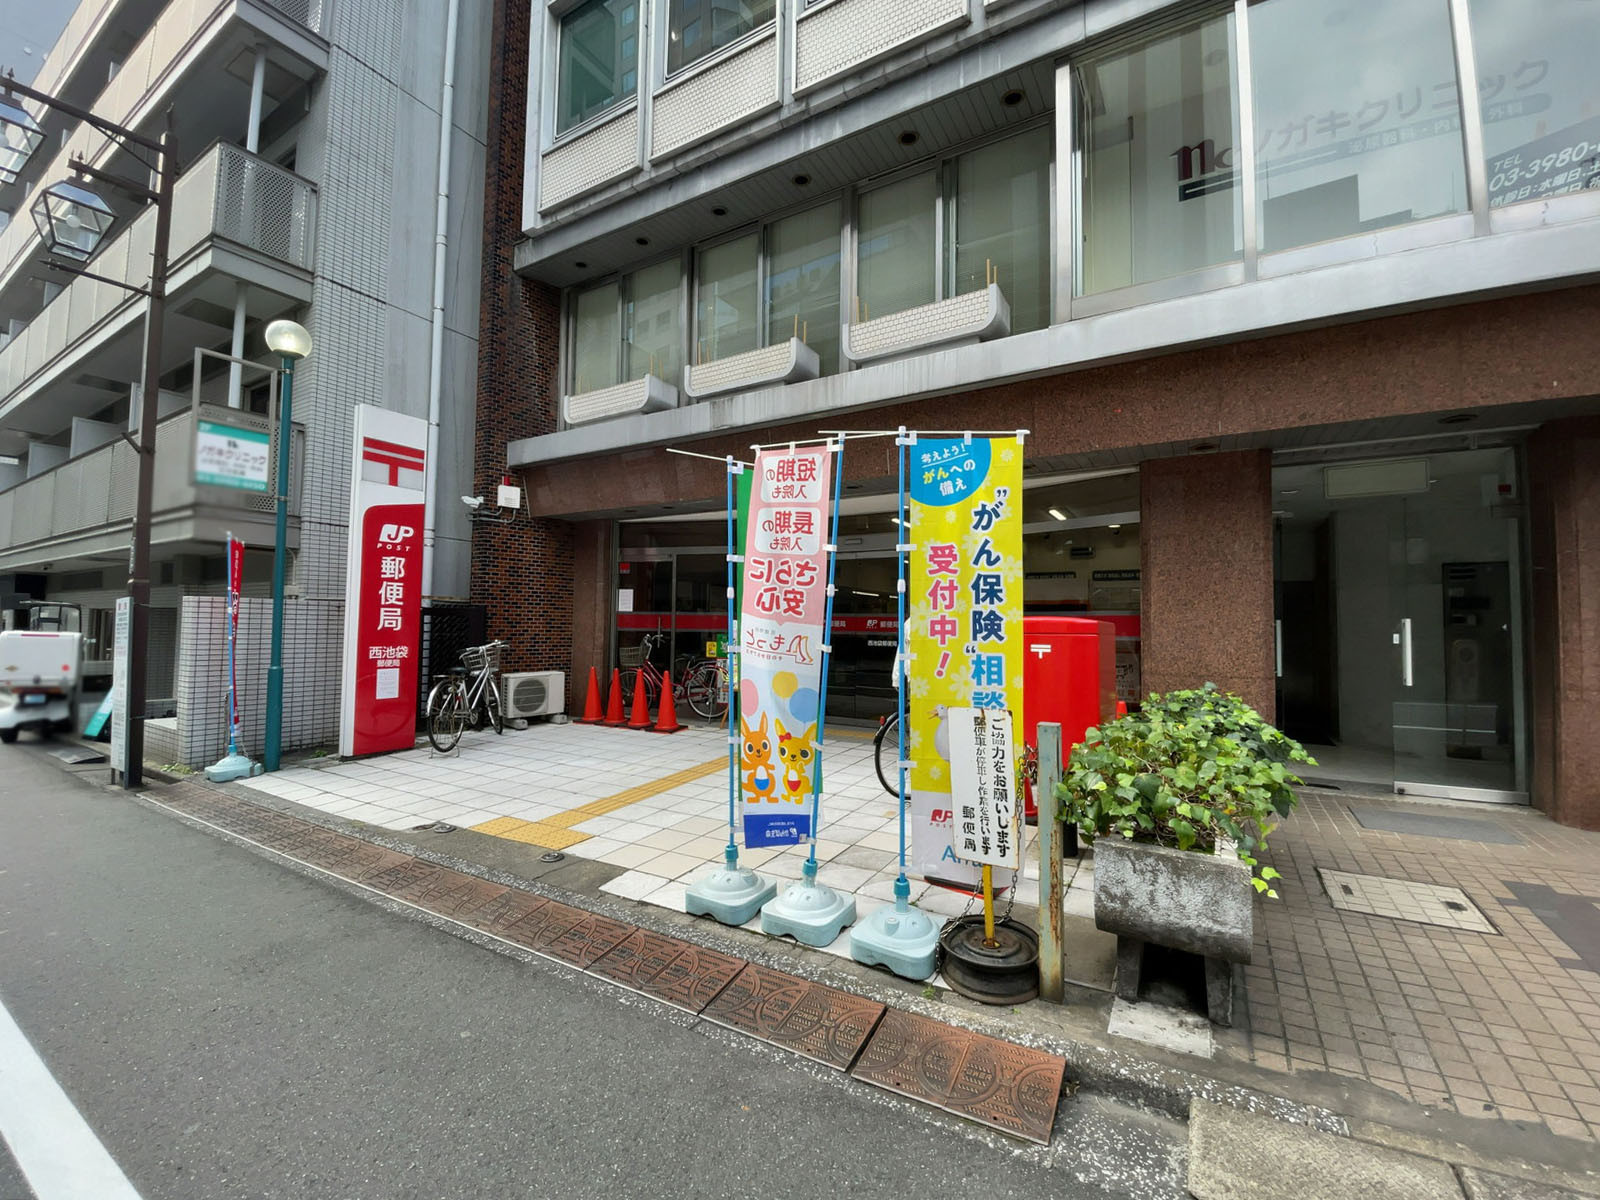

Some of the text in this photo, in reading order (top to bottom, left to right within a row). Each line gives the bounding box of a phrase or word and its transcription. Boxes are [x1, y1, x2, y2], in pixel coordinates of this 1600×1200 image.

[1489, 142, 1600, 191] 03-3980-
[1494, 154, 1521, 172] TEL
[921, 443, 966, 464] 考えよう！
[923, 459, 976, 485] がんへの
[940, 478, 967, 496] 備え
[377, 543, 411, 552] POST
[377, 556, 406, 631] 郵便局
[928, 544, 958, 678] 受付中！
[369, 645, 409, 659] 西池袋
[992, 718, 1010, 858] ご協力をお願いします
[962, 806, 976, 852] 郵便局
